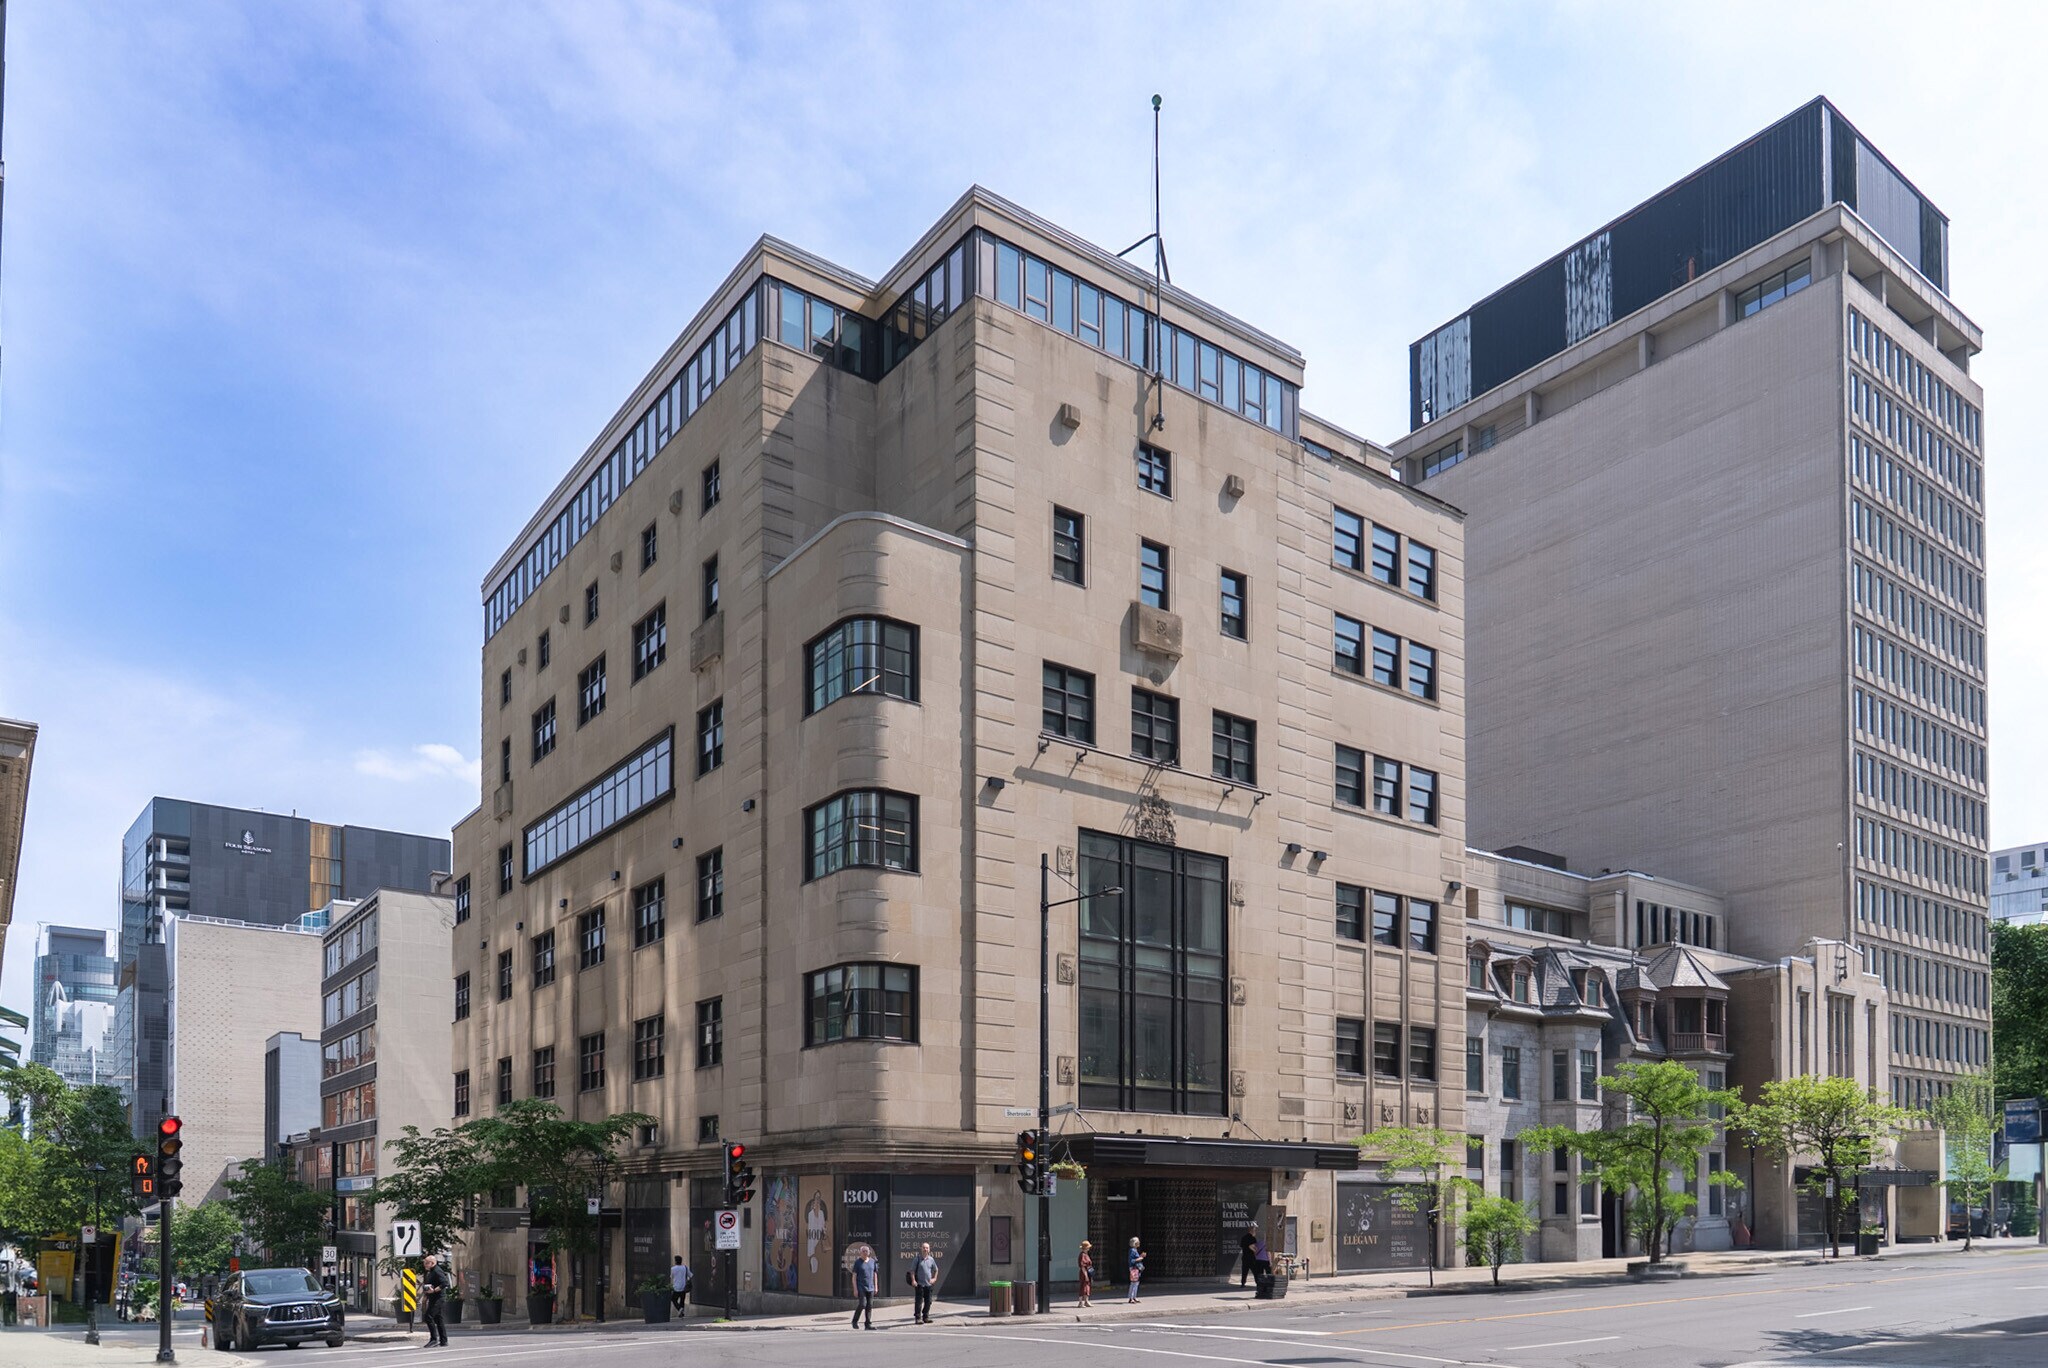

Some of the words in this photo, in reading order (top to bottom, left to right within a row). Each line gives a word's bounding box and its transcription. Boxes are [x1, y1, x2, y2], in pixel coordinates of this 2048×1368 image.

[843, 1190, 878, 1203] 1300
[901, 1210, 942, 1218] DÉCOUVREZ
[1343, 1233, 1378, 1245] ÉLÉGANT
[324, 1250, 335, 1258] 30
